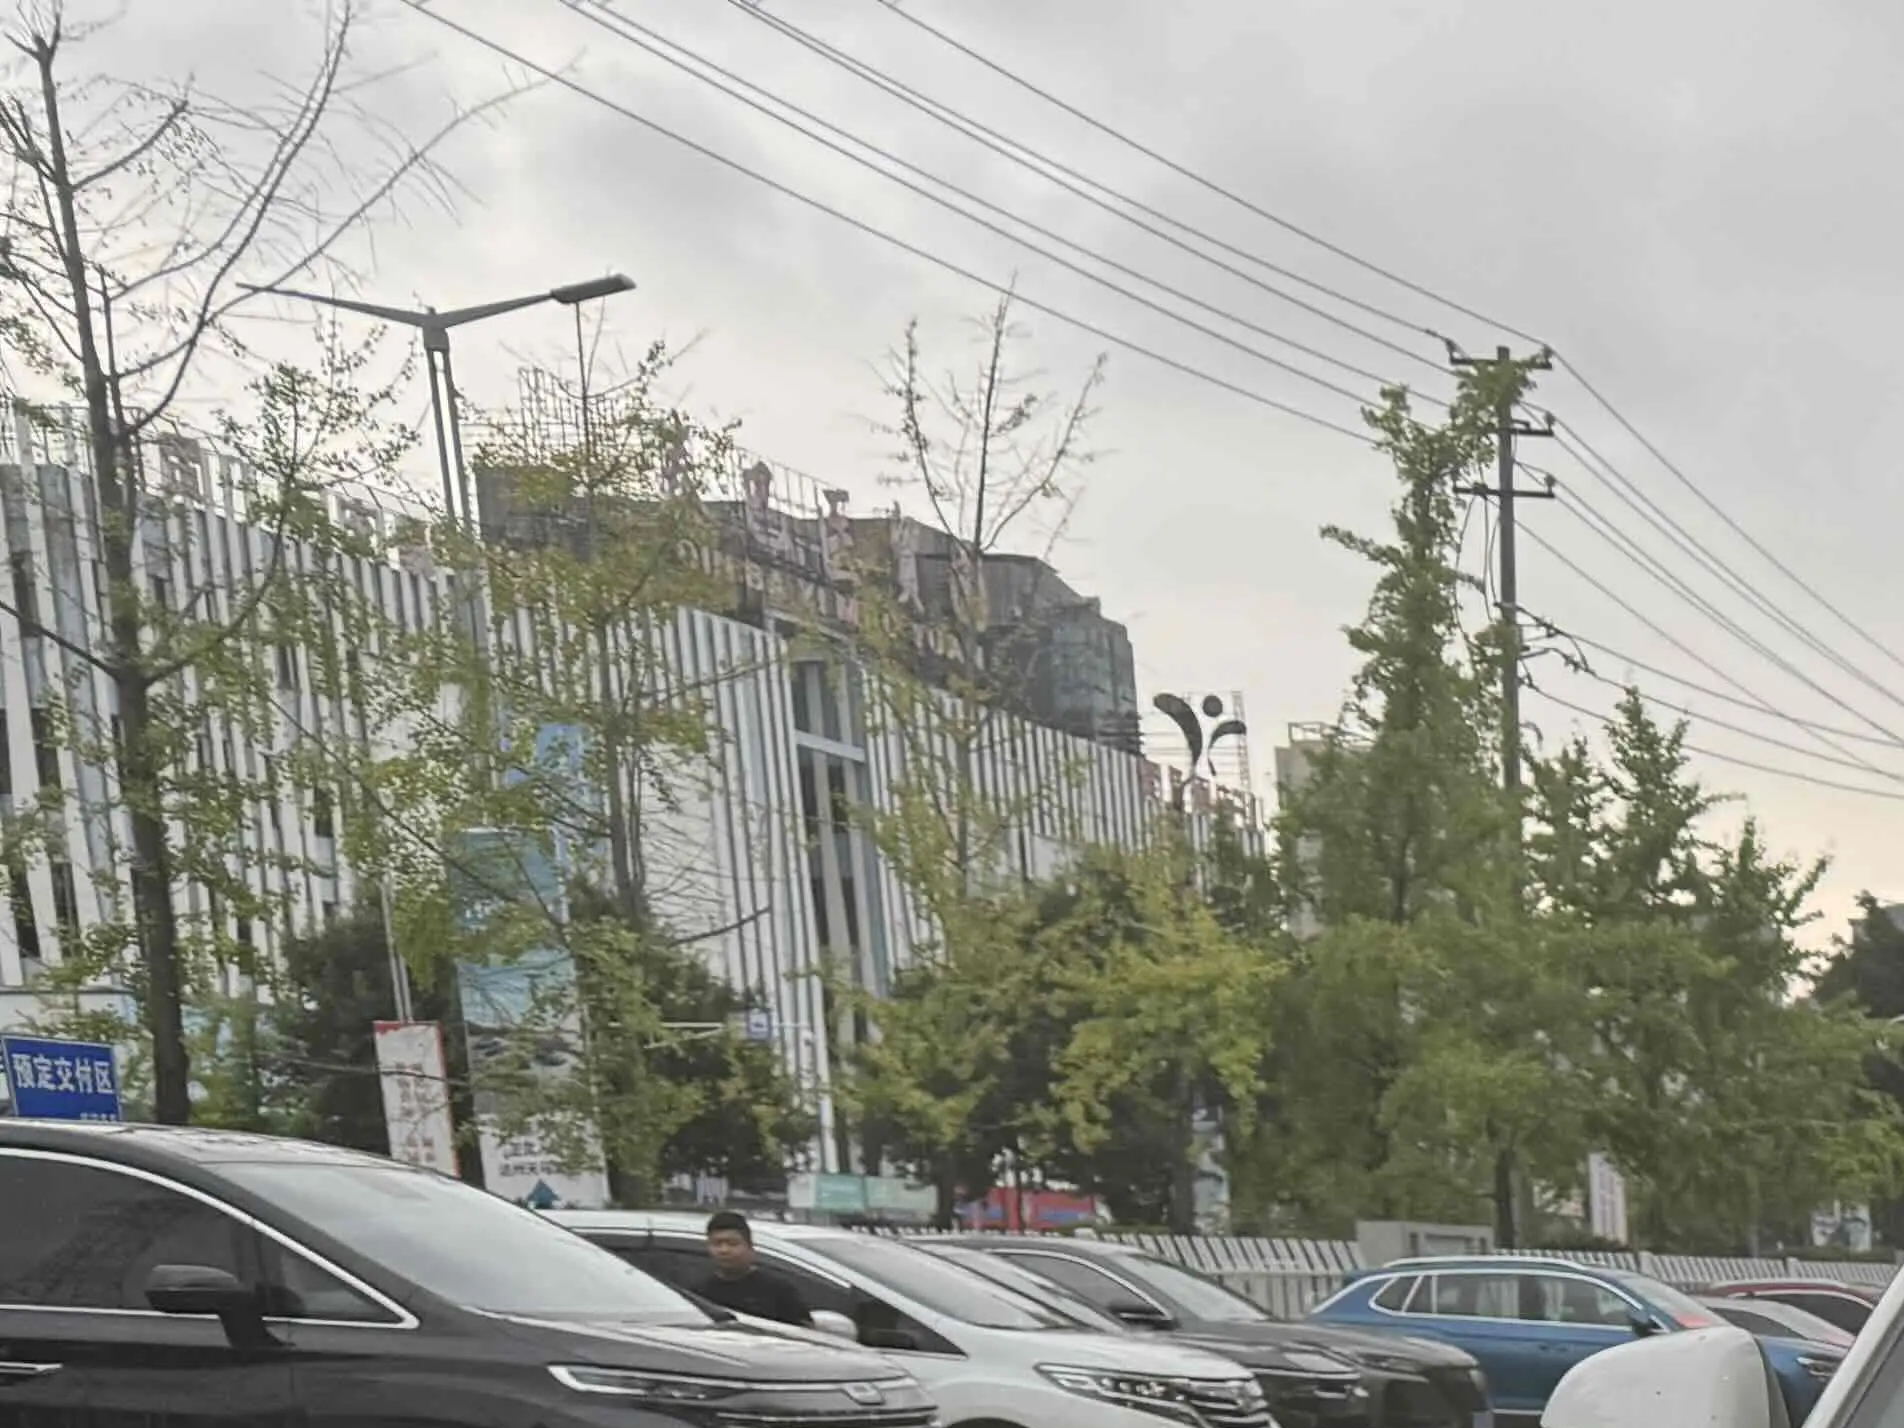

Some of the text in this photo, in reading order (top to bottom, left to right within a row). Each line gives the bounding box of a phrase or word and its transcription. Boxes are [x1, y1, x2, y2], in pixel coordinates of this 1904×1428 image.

[11, 1053, 115, 1094] 预定交付区
